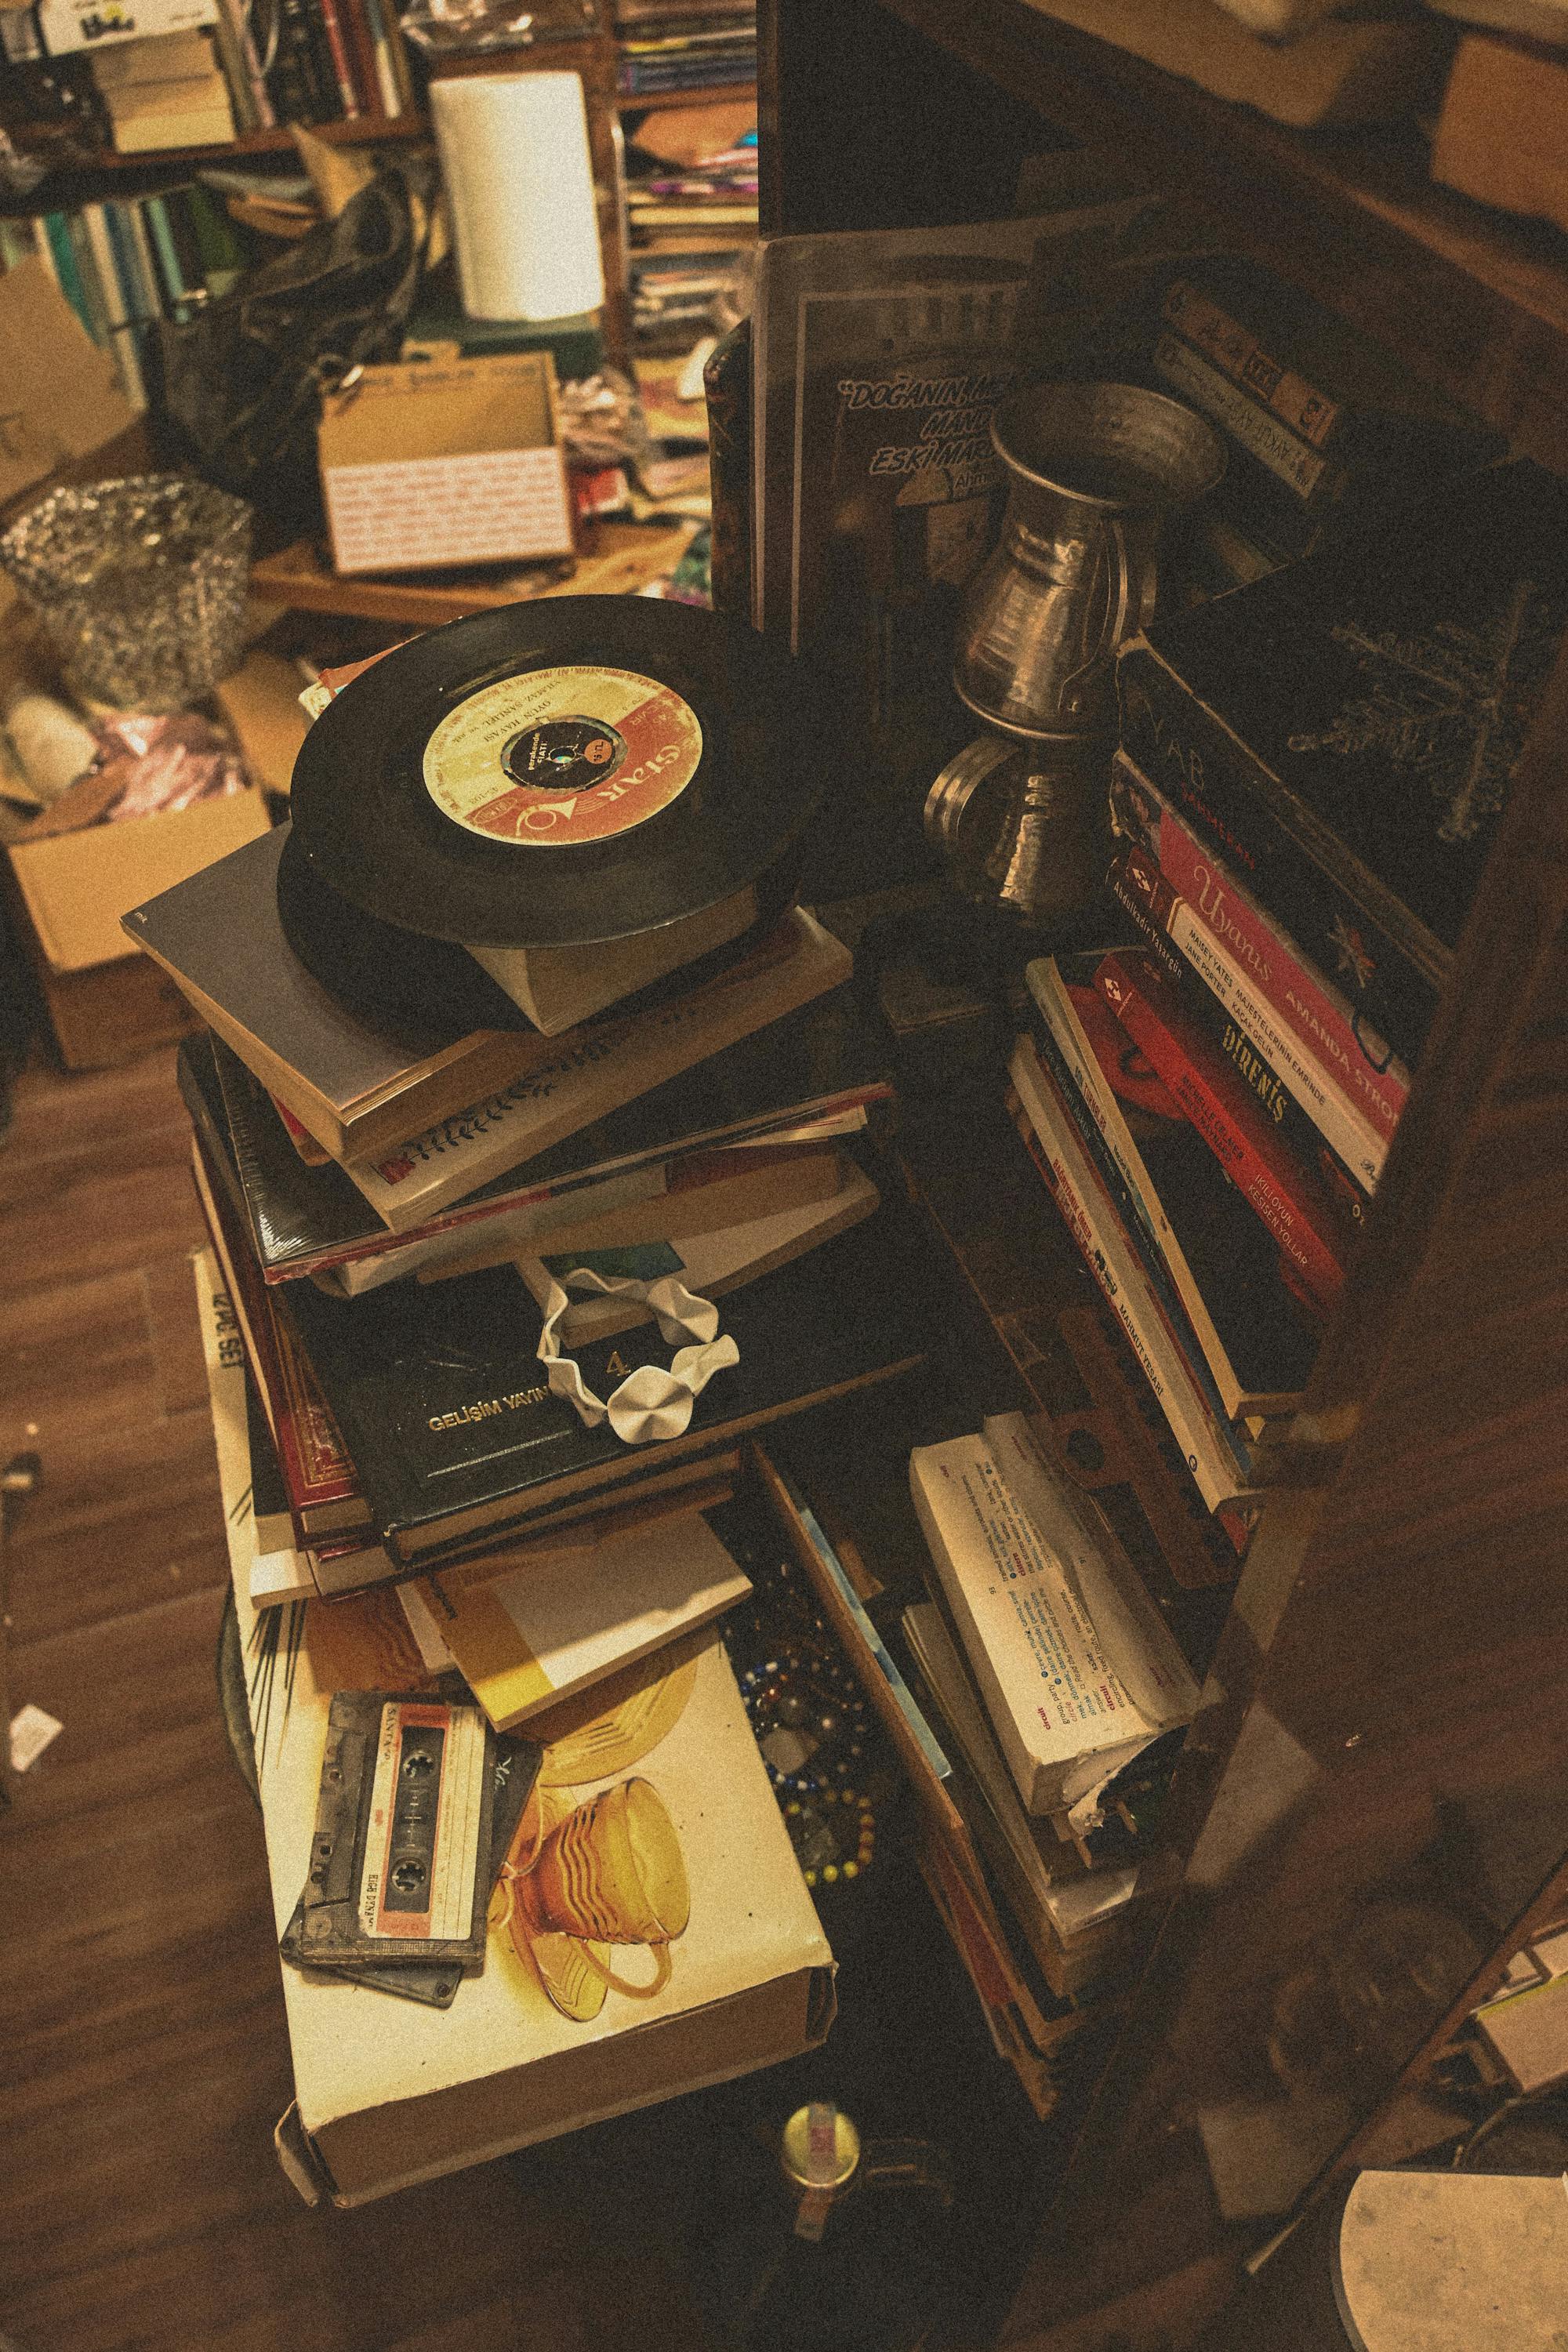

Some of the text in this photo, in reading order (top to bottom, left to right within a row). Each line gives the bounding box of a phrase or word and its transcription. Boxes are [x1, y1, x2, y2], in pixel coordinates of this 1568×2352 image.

[869, 441, 932, 475] ESKİ
[484, 699, 551, 742] OYUN HAVASI
[528, 733, 540, 771] perakende
[597, 744, 680, 801] STAR
[1112, 878, 1152, 937] Abdulkadir
[1185, 929, 1214, 960] MAISEY
[1208, 957, 1236, 989] YATES
[1182, 942, 1202, 964] JANE
[1197, 961, 1228, 997] PORTER
[1230, 1000, 1254, 1033] KAÇAK
[1285, 989, 1349, 1069] AMANDA
[1268, 1196, 1296, 1228] OYUN
[1273, 1224, 1311, 1268] YOLLAR
[1076, 1209, 1094, 1241] ÖMER
[1116, 1303, 1145, 1355] MAHMUT
[604, 1352, 631, 1377] 4
[428, 1399, 503, 1434] GELİŞİM
[968, 1494, 980, 1507] and
[984, 1488, 998, 1505] tank,
[1016, 1539, 1030, 1560] stores
[994, 1559, 1011, 1582] trained
[1010, 1551, 1027, 1577] cistern
[1024, 1559, 1036, 1574] that
[1047, 1614, 1061, 1629] and
[1067, 1613, 1083, 1634] route,
[1053, 1628, 1071, 1654] choices
[1085, 1633, 1102, 1655] route,
[1052, 1650, 1067, 1671] daire
[1064, 1653, 1076, 1666] the
[1094, 1654, 1109, 1673] fixed
[1061, 1670, 1080, 1701] dönmek,
[1069, 1664, 1083, 1682] Read
[1045, 1682, 1061, 1702] party
[1089, 1687, 1108, 1715] answer.
[1097, 1683, 1117, 1712] circuit
[1103, 1671, 1127, 1709] encircling,
[1036, 1705, 1052, 1731] circuit
[1053, 1701, 1071, 1726] group,
[1062, 1700, 1079, 1723] circle
[1073, 1700, 1089, 1719] mek,
[1081, 1693, 1098, 1717] almak
[383, 1707, 397, 1747] SANTA
[365, 1873, 378, 1893] HIGH
